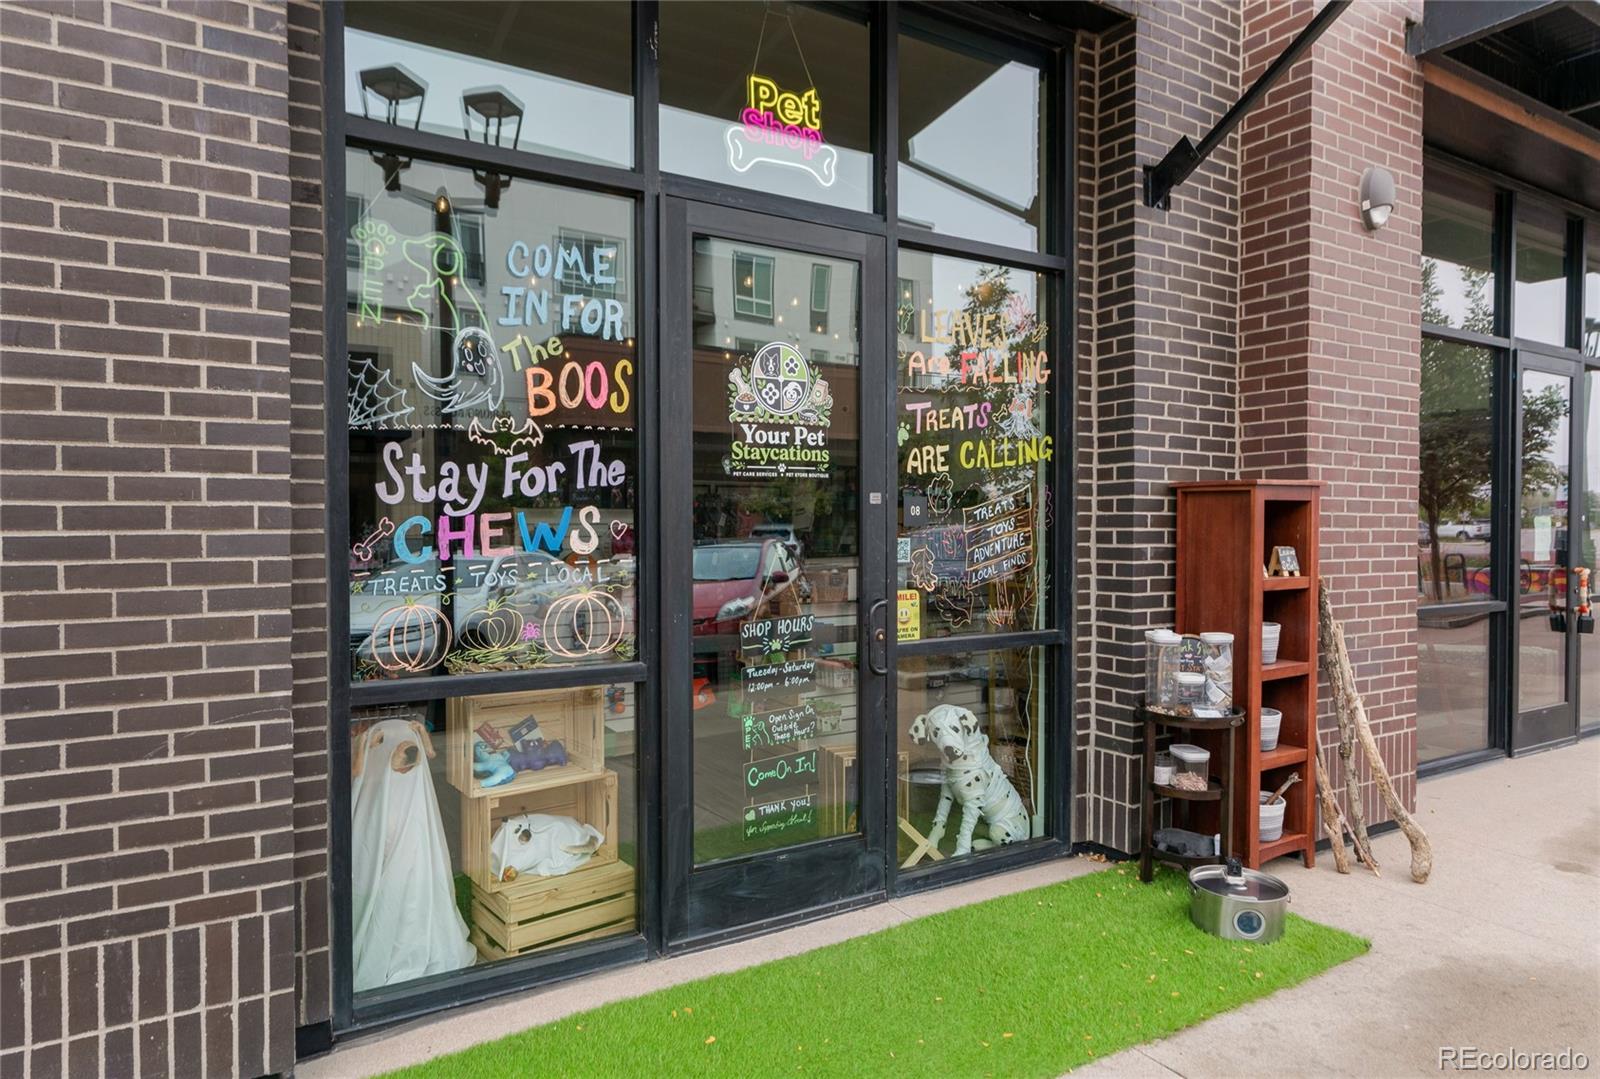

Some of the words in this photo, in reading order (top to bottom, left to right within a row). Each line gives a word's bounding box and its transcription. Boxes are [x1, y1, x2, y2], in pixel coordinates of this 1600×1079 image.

[750, 76, 820, 130] Pet
[742, 108, 822, 159] Shop
[507, 240, 617, 284] COME
[498, 286, 549, 326] IN
[562, 294, 624, 341] FOR
[502, 336, 563, 371] The
[960, 351, 1051, 385] FALLING
[526, 359, 633, 416] BOOS
[740, 423, 790, 445] Your
[794, 426, 825, 446] Pet
[731, 440, 830, 465] Staycations
[906, 444, 950, 475] ARE
[959, 435, 1053, 469] CALLING
[375, 441, 489, 516] Stay
[503, 452, 566, 498] For
[568, 440, 626, 489] The
[910, 505, 921, 516] 08
[973, 497, 1016, 522] TREATS
[393, 505, 601, 564] CHEWS
[986, 516, 1016, 539] TOYS
[973, 532, 1026, 563] ADVENTURE
[368, 574, 448, 596] TREATS
[470, 569, 519, 587] TOYS
[545, 567, 611, 585] LOCAL
[971, 568, 998, 584] LOCAL
[1003, 552, 1028, 571] FINDS
[742, 621, 772, 638] SHOP
[777, 615, 815, 634] HOURS
[795, 752, 816, 774] In!
[759, 800, 787, 816] THANK
